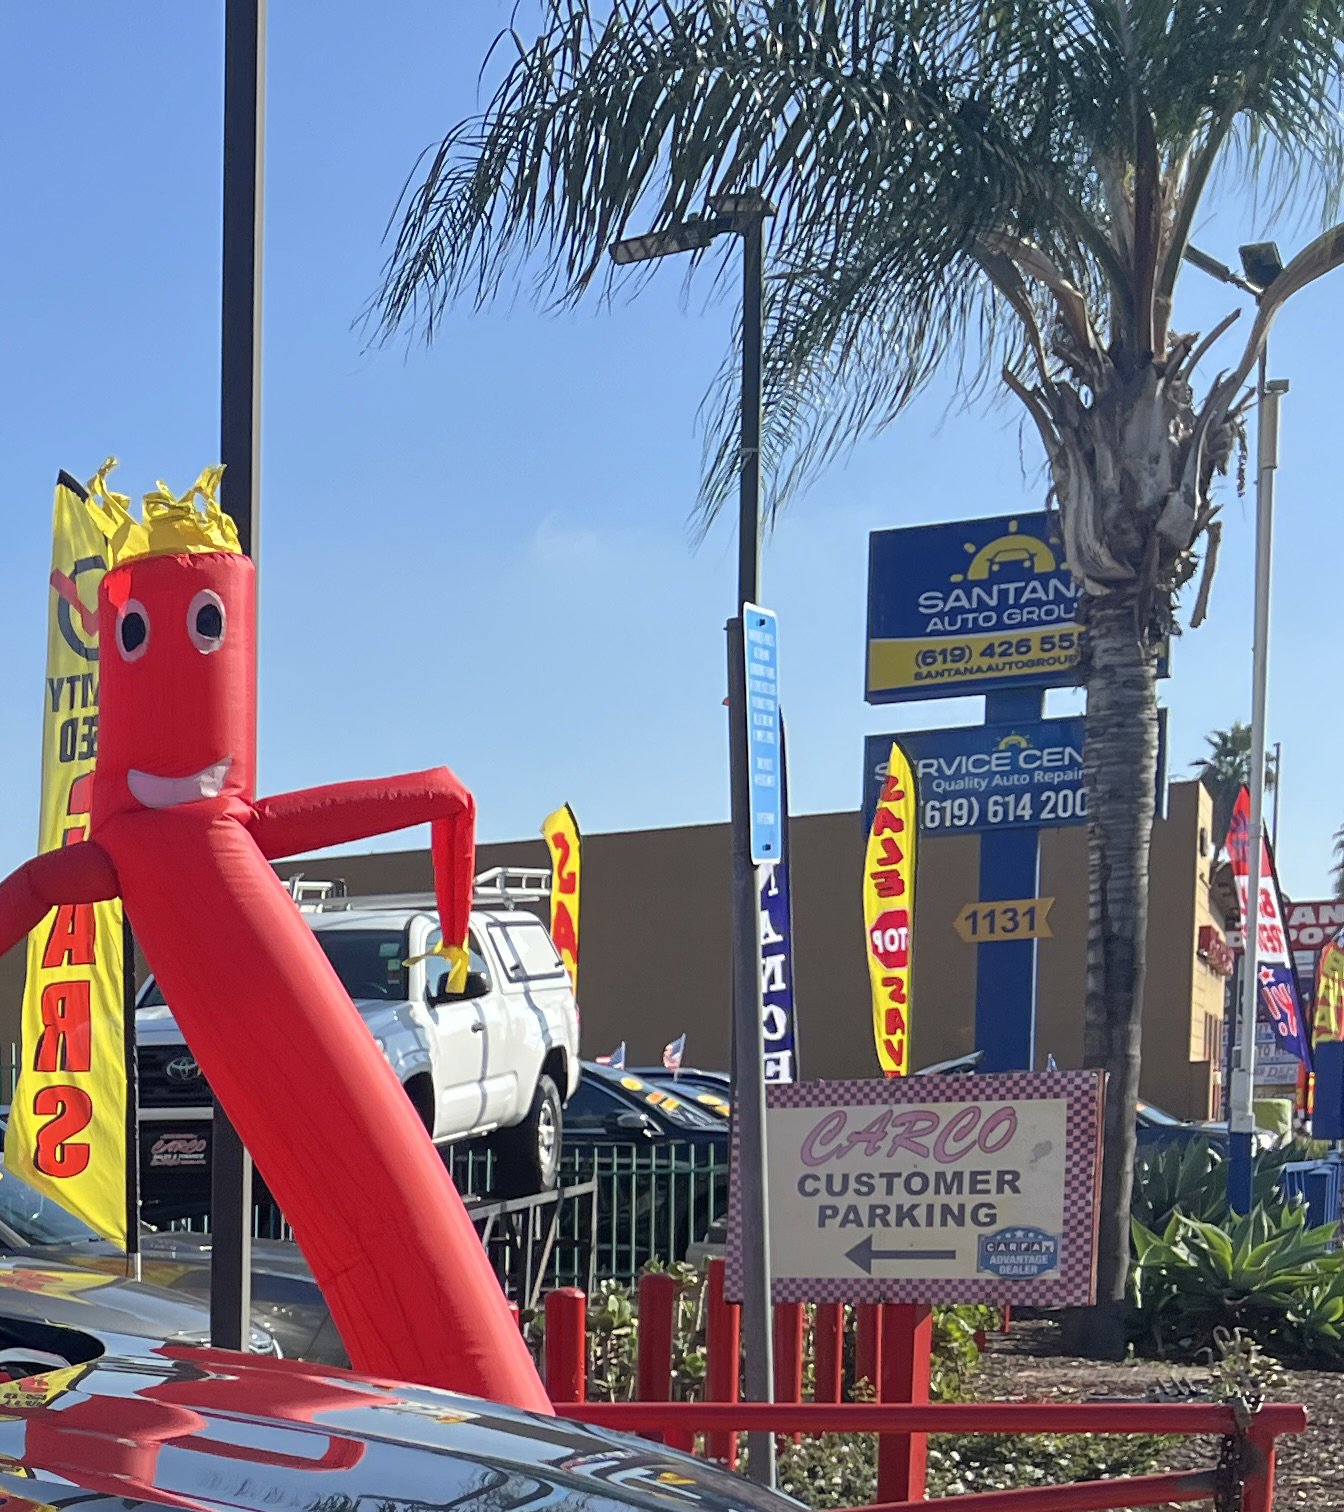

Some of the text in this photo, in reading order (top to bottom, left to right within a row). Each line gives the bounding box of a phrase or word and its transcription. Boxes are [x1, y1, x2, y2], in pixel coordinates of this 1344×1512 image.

[918, 578, 1084, 614] SANTAN
[925, 602, 1078, 633] AUTO GROU
[914, 654, 1079, 681] SANTANAAUTOGROUP
[915, 646, 973, 670] (619)
[979, 637, 1032, 660] 426
[874, 746, 1083, 783] SRVICE CEN
[932, 776, 988, 793] Quality
[991, 773, 1030, 788] Auto
[987, 792, 1033, 823] 614
[965, 906, 1036, 935] 1131
[800, 1105, 1018, 1167] CARCO
[797, 1169, 1022, 1197] CUSTOMER
[818, 1202, 997, 1228] PARKING
[989, 1253, 1049, 1266] ADVANTAGE
[998, 1264, 1039, 1275] DEALER
